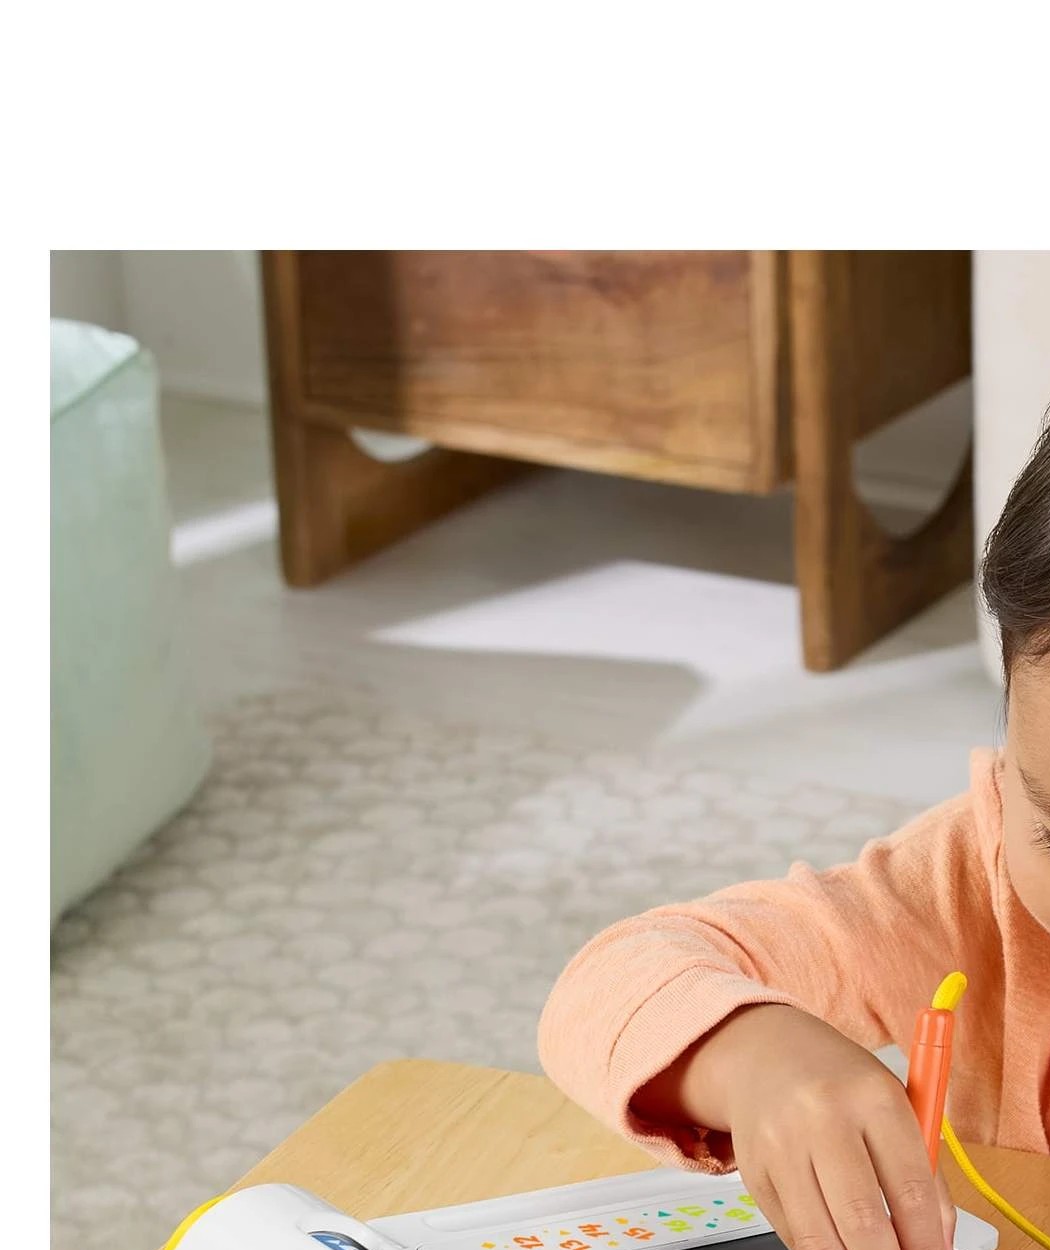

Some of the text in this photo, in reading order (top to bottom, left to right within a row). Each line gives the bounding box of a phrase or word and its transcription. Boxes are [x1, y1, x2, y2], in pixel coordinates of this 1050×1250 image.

[578, 1223, 609, 1239] 14
[623, 1227, 656, 1241] 15
[513, 1235, 544, 1250] 12
